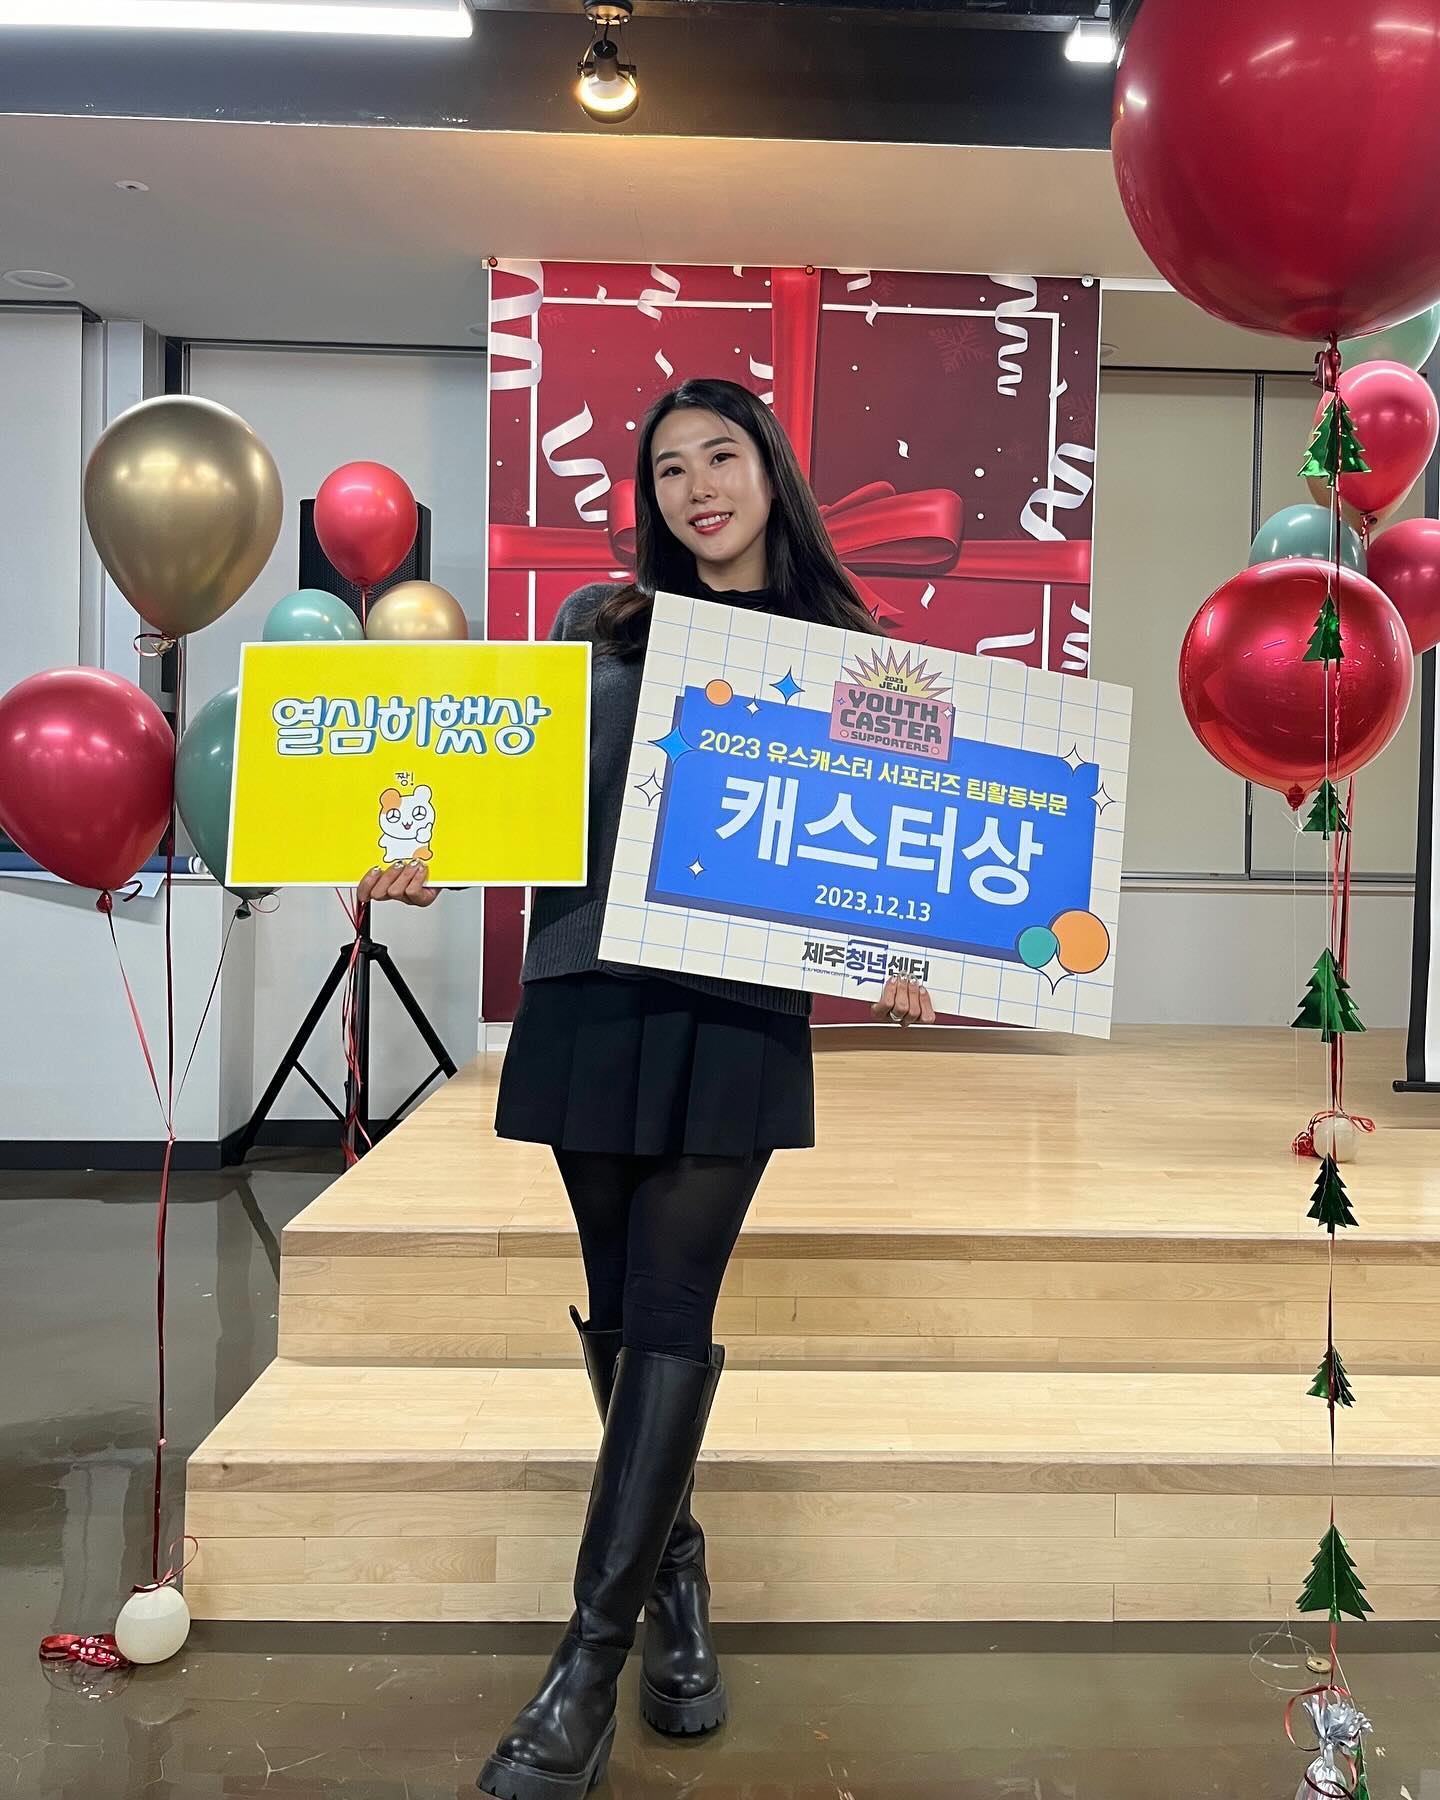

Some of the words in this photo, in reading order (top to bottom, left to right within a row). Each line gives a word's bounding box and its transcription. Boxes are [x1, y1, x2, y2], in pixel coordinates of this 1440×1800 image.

[879, 681, 908, 693] JEJU
[884, 675, 904, 684] 2023
[848, 689, 939, 723] YOUTH
[272, 694, 552, 756] 열심히했상
[840, 709, 942, 744] CASTER
[850, 731, 929, 753] SUPPORTERS
[395, 771, 414, 787] 짱!
[699, 729, 761, 759] 2023
[767, 741, 873, 780] 유스캐스터
[877, 762, 961, 796] 서포터즈
[966, 778, 1068, 816] 팀활동부문
[715, 775, 1044, 906] 캐스터상
[814, 884, 932, 922] 2023.12.13
[801, 941, 930, 982] 제주청년센터
